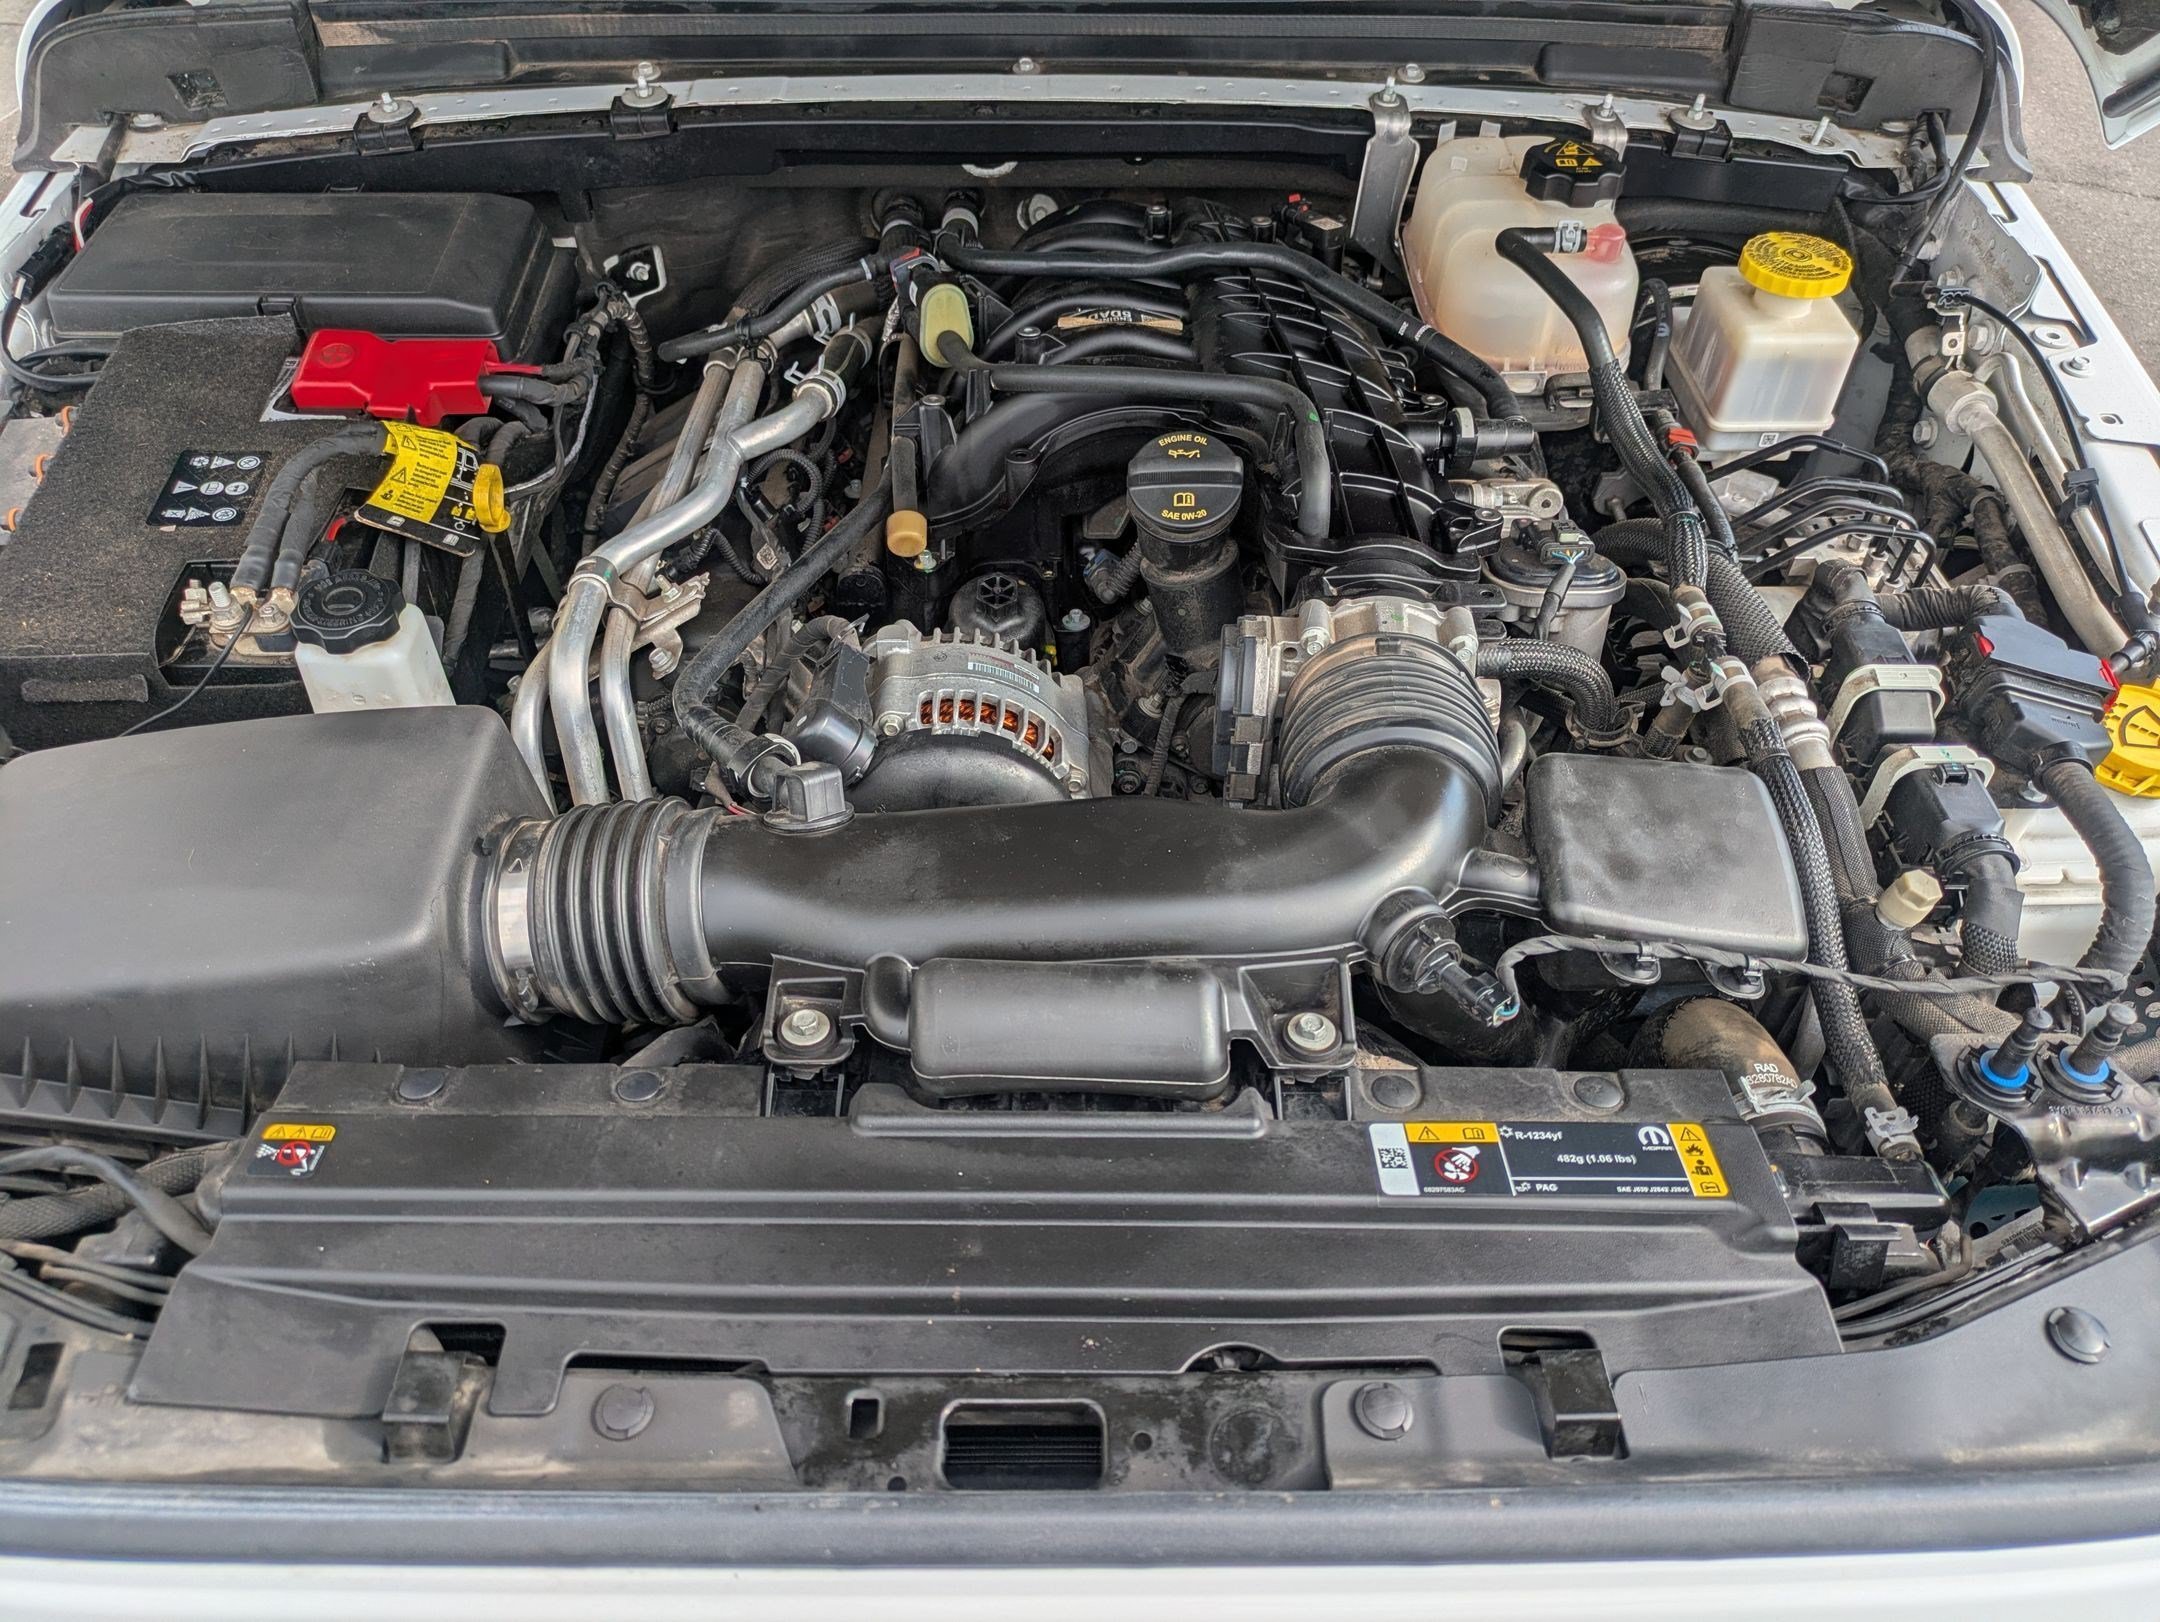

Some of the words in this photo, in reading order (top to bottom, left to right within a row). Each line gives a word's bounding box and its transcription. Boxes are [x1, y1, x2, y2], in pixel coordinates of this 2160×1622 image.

[1158, 434, 1192, 447] ENGINE
[1193, 435, 1208, 446] OIL
[1161, 509, 1180, 520] SAE
[1181, 509, 1208, 521] 0W-20
[1753, 1063, 1779, 1073] RAD
[1514, 1131, 1563, 1142] R-1234yf
[1556, 1154, 1584, 1165] 482g
[1585, 1153, 1613, 1165] (1.06
[1614, 1153, 1638, 1165] lbs)
[1535, 1183, 1559, 1192] PAG
